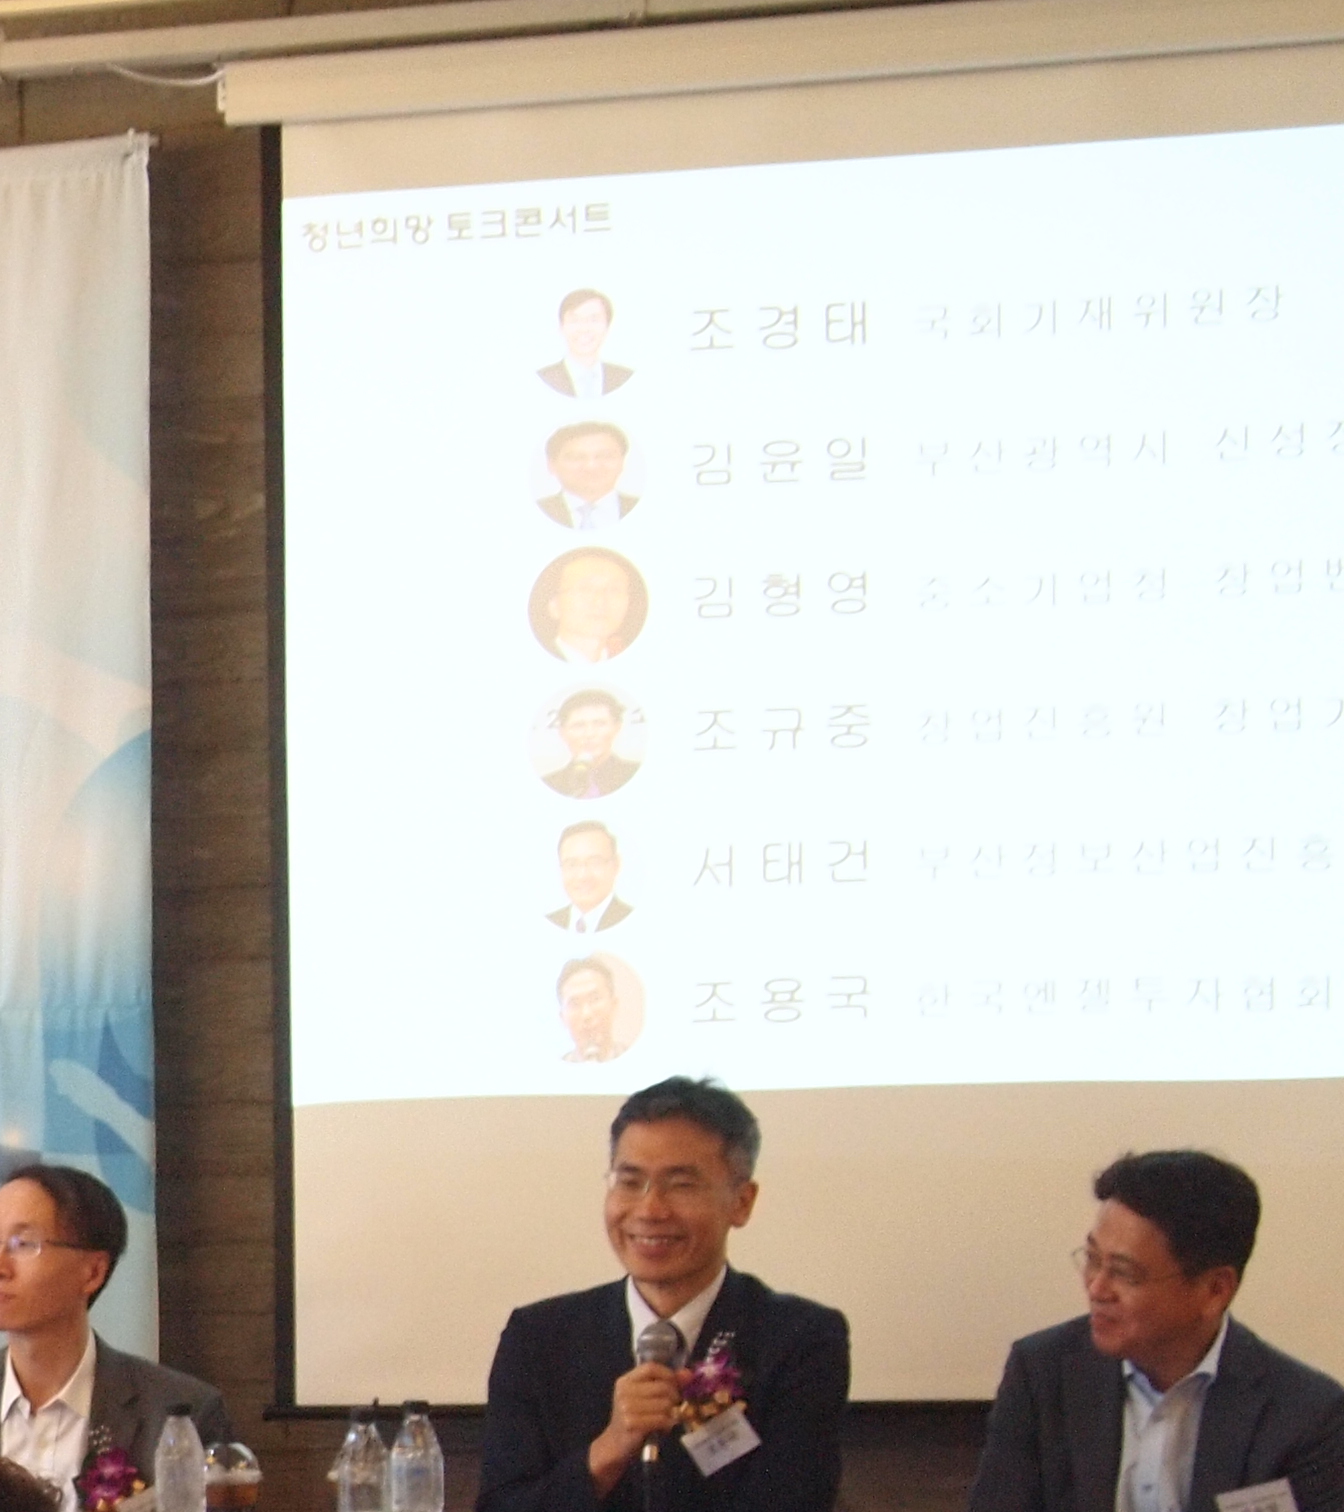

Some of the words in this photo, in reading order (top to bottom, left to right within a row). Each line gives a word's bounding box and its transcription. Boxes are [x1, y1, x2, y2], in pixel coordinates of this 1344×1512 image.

[447, 202, 612, 241] 토크콘서트
[690, 300, 868, 351] 조경태
[692, 436, 867, 486] 김윤일
[916, 430, 1168, 478] 부산광역시
[693, 570, 868, 619] 김형영
[692, 703, 871, 752] 조규중
[692, 838, 868, 888] 서태건
[692, 974, 870, 1025] 조용국
